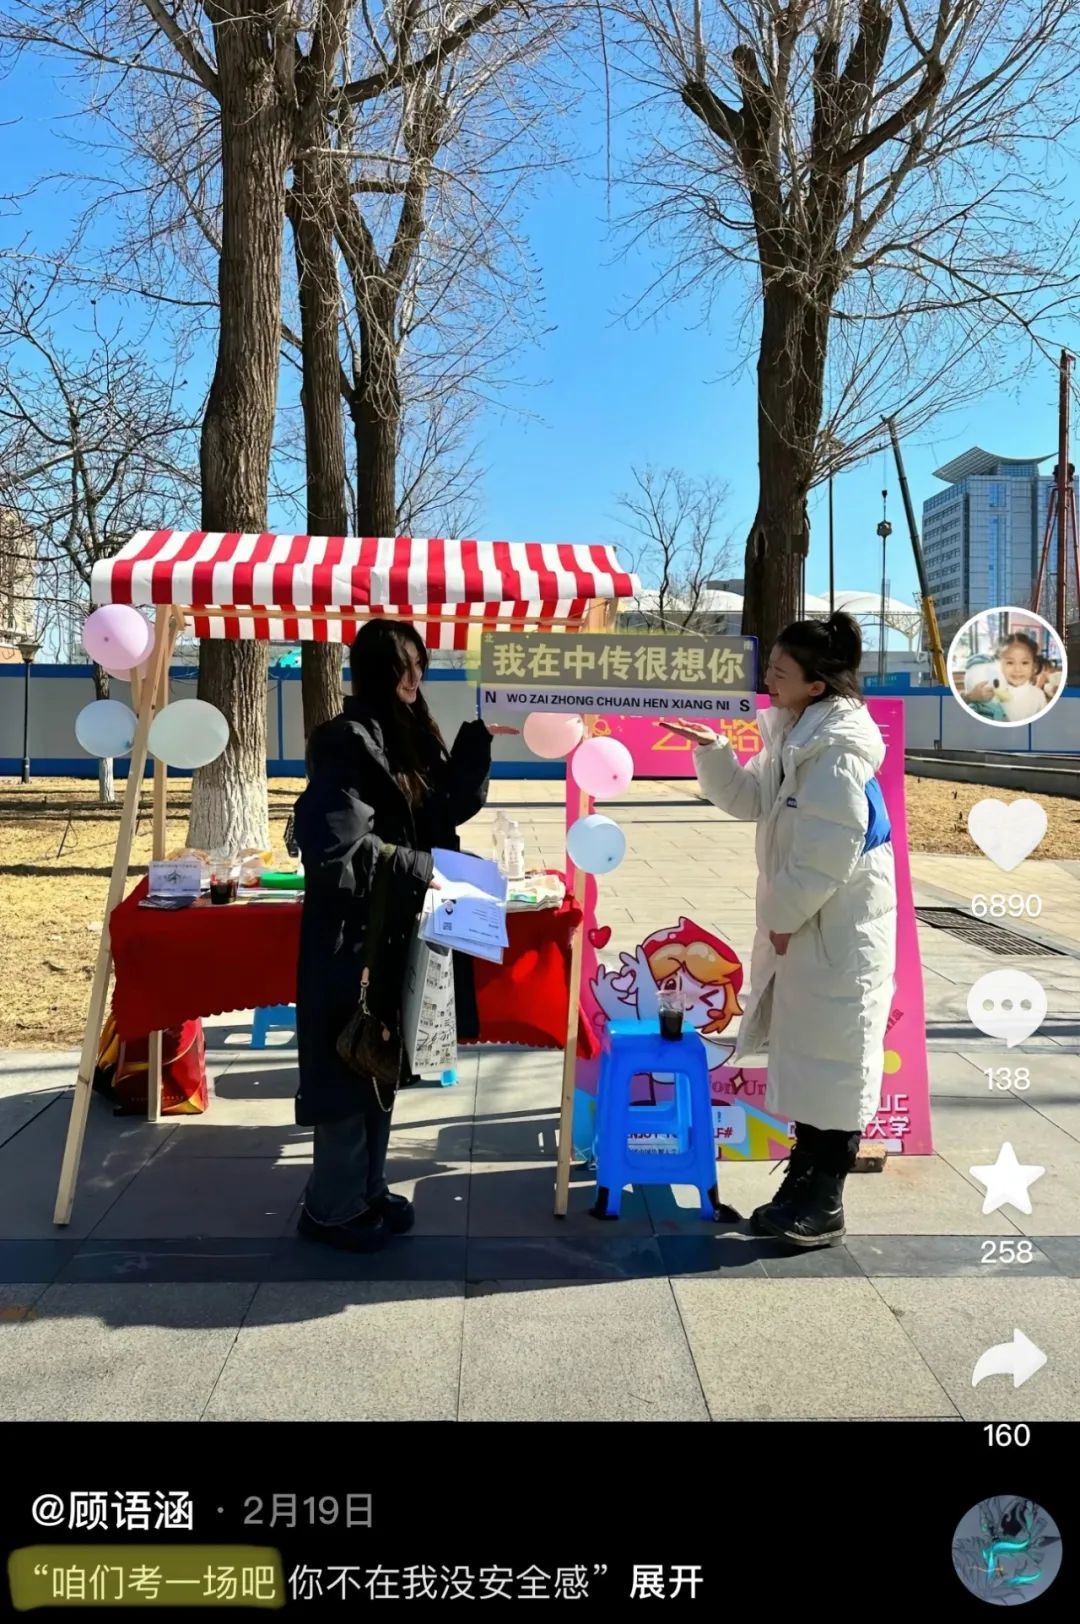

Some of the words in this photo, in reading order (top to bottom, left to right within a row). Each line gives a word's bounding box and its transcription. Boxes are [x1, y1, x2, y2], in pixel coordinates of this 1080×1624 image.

[493, 643, 745, 684] 我在中传很想你
[485, 691, 497, 704] N
[506, 693, 527, 704] WO
[529, 694, 549, 705] ZAI
[551, 694, 594, 707] ZHONG
[596, 696, 640, 708] CHUAN
[643, 698, 669, 708] HEN
[671, 699, 713, 711] XIANG
[716, 700, 730, 711] NI
[739, 699, 751, 713] S
[862, 1115, 911, 1138] 大学
